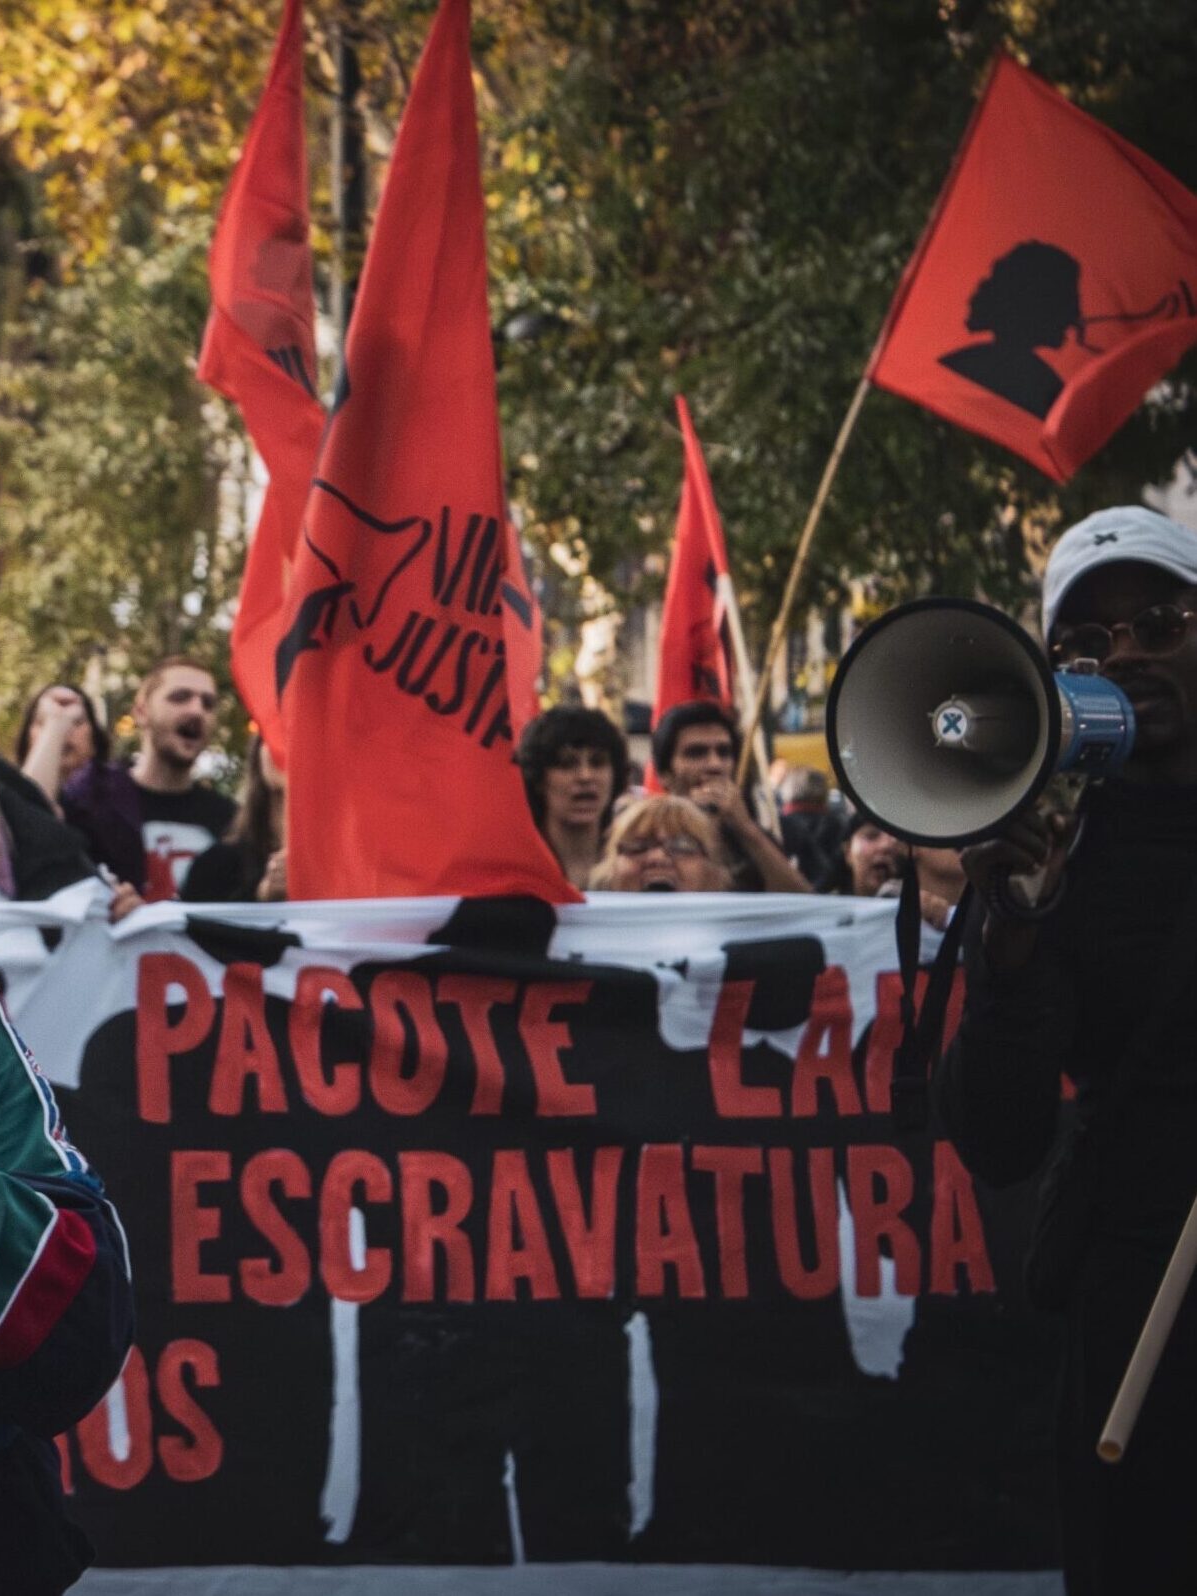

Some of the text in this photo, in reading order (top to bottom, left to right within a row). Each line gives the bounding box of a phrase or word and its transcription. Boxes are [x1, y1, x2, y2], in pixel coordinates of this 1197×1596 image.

[136, 951, 598, 1124] PACOTE
[171, 1140, 997, 1307] ESCRAVATURA
[53, 1337, 224, 1495] OS
